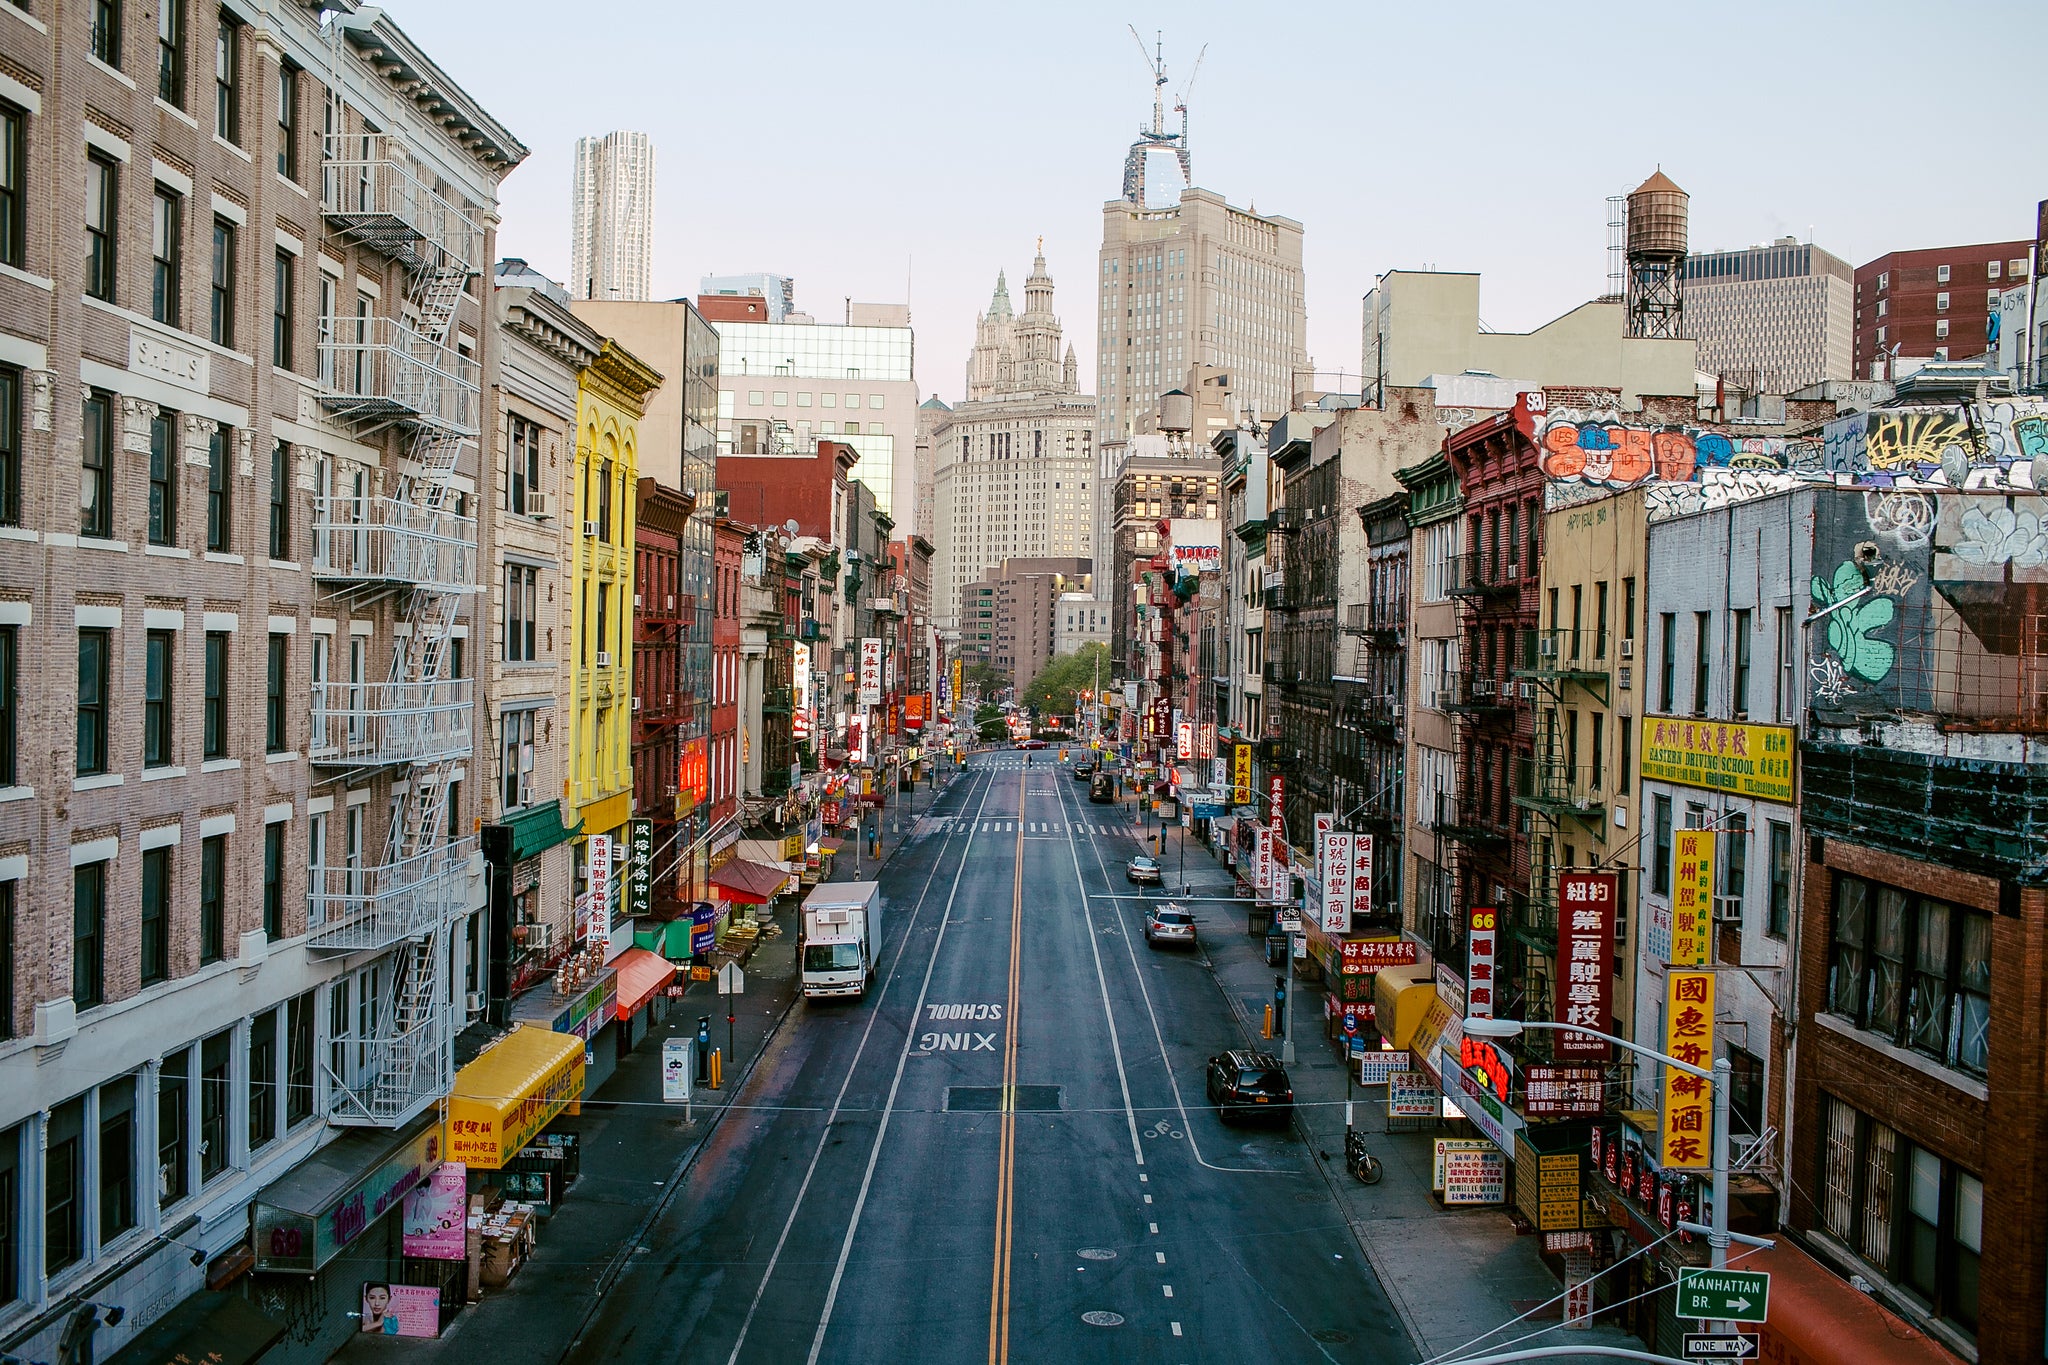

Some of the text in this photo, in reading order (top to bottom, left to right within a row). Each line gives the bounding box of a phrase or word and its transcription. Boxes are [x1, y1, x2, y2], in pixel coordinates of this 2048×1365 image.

[1654, 722, 1747, 756] 廣州駕駛學校
[1649, 748, 1682, 765] EASTERN
[1685, 753, 1718, 770] DRIVING
[1721, 756, 1755, 776] SCHOOL
[1566, 882, 1609, 902] 紐約
[1677, 836, 1698, 965] 廣州駕駛學
[1472, 913, 1494, 929] 66
[1567, 910, 1603, 1027] 第一駕駛學校
[1344, 978, 1376, 999] 福州
[1470, 938, 1493, 1020] 福宝商
[926, 1004, 1002, 1020] SCHOOL
[919, 1032, 997, 1051] XING
[1477, 1068, 1488, 1088] 66
[1668, 977, 1709, 1163] 國惠海鮮酒家
[453, 1140, 497, 1153] 福州小吃店
[455, 1155, 498, 1164] 212-791-2819
[270, 1227, 302, 1257] 69
[1687, 1277, 1760, 1295] MANHATTAN
[1692, 1295, 1711, 1309] BR.
[1695, 1341, 1748, 1351] ONE WAY
